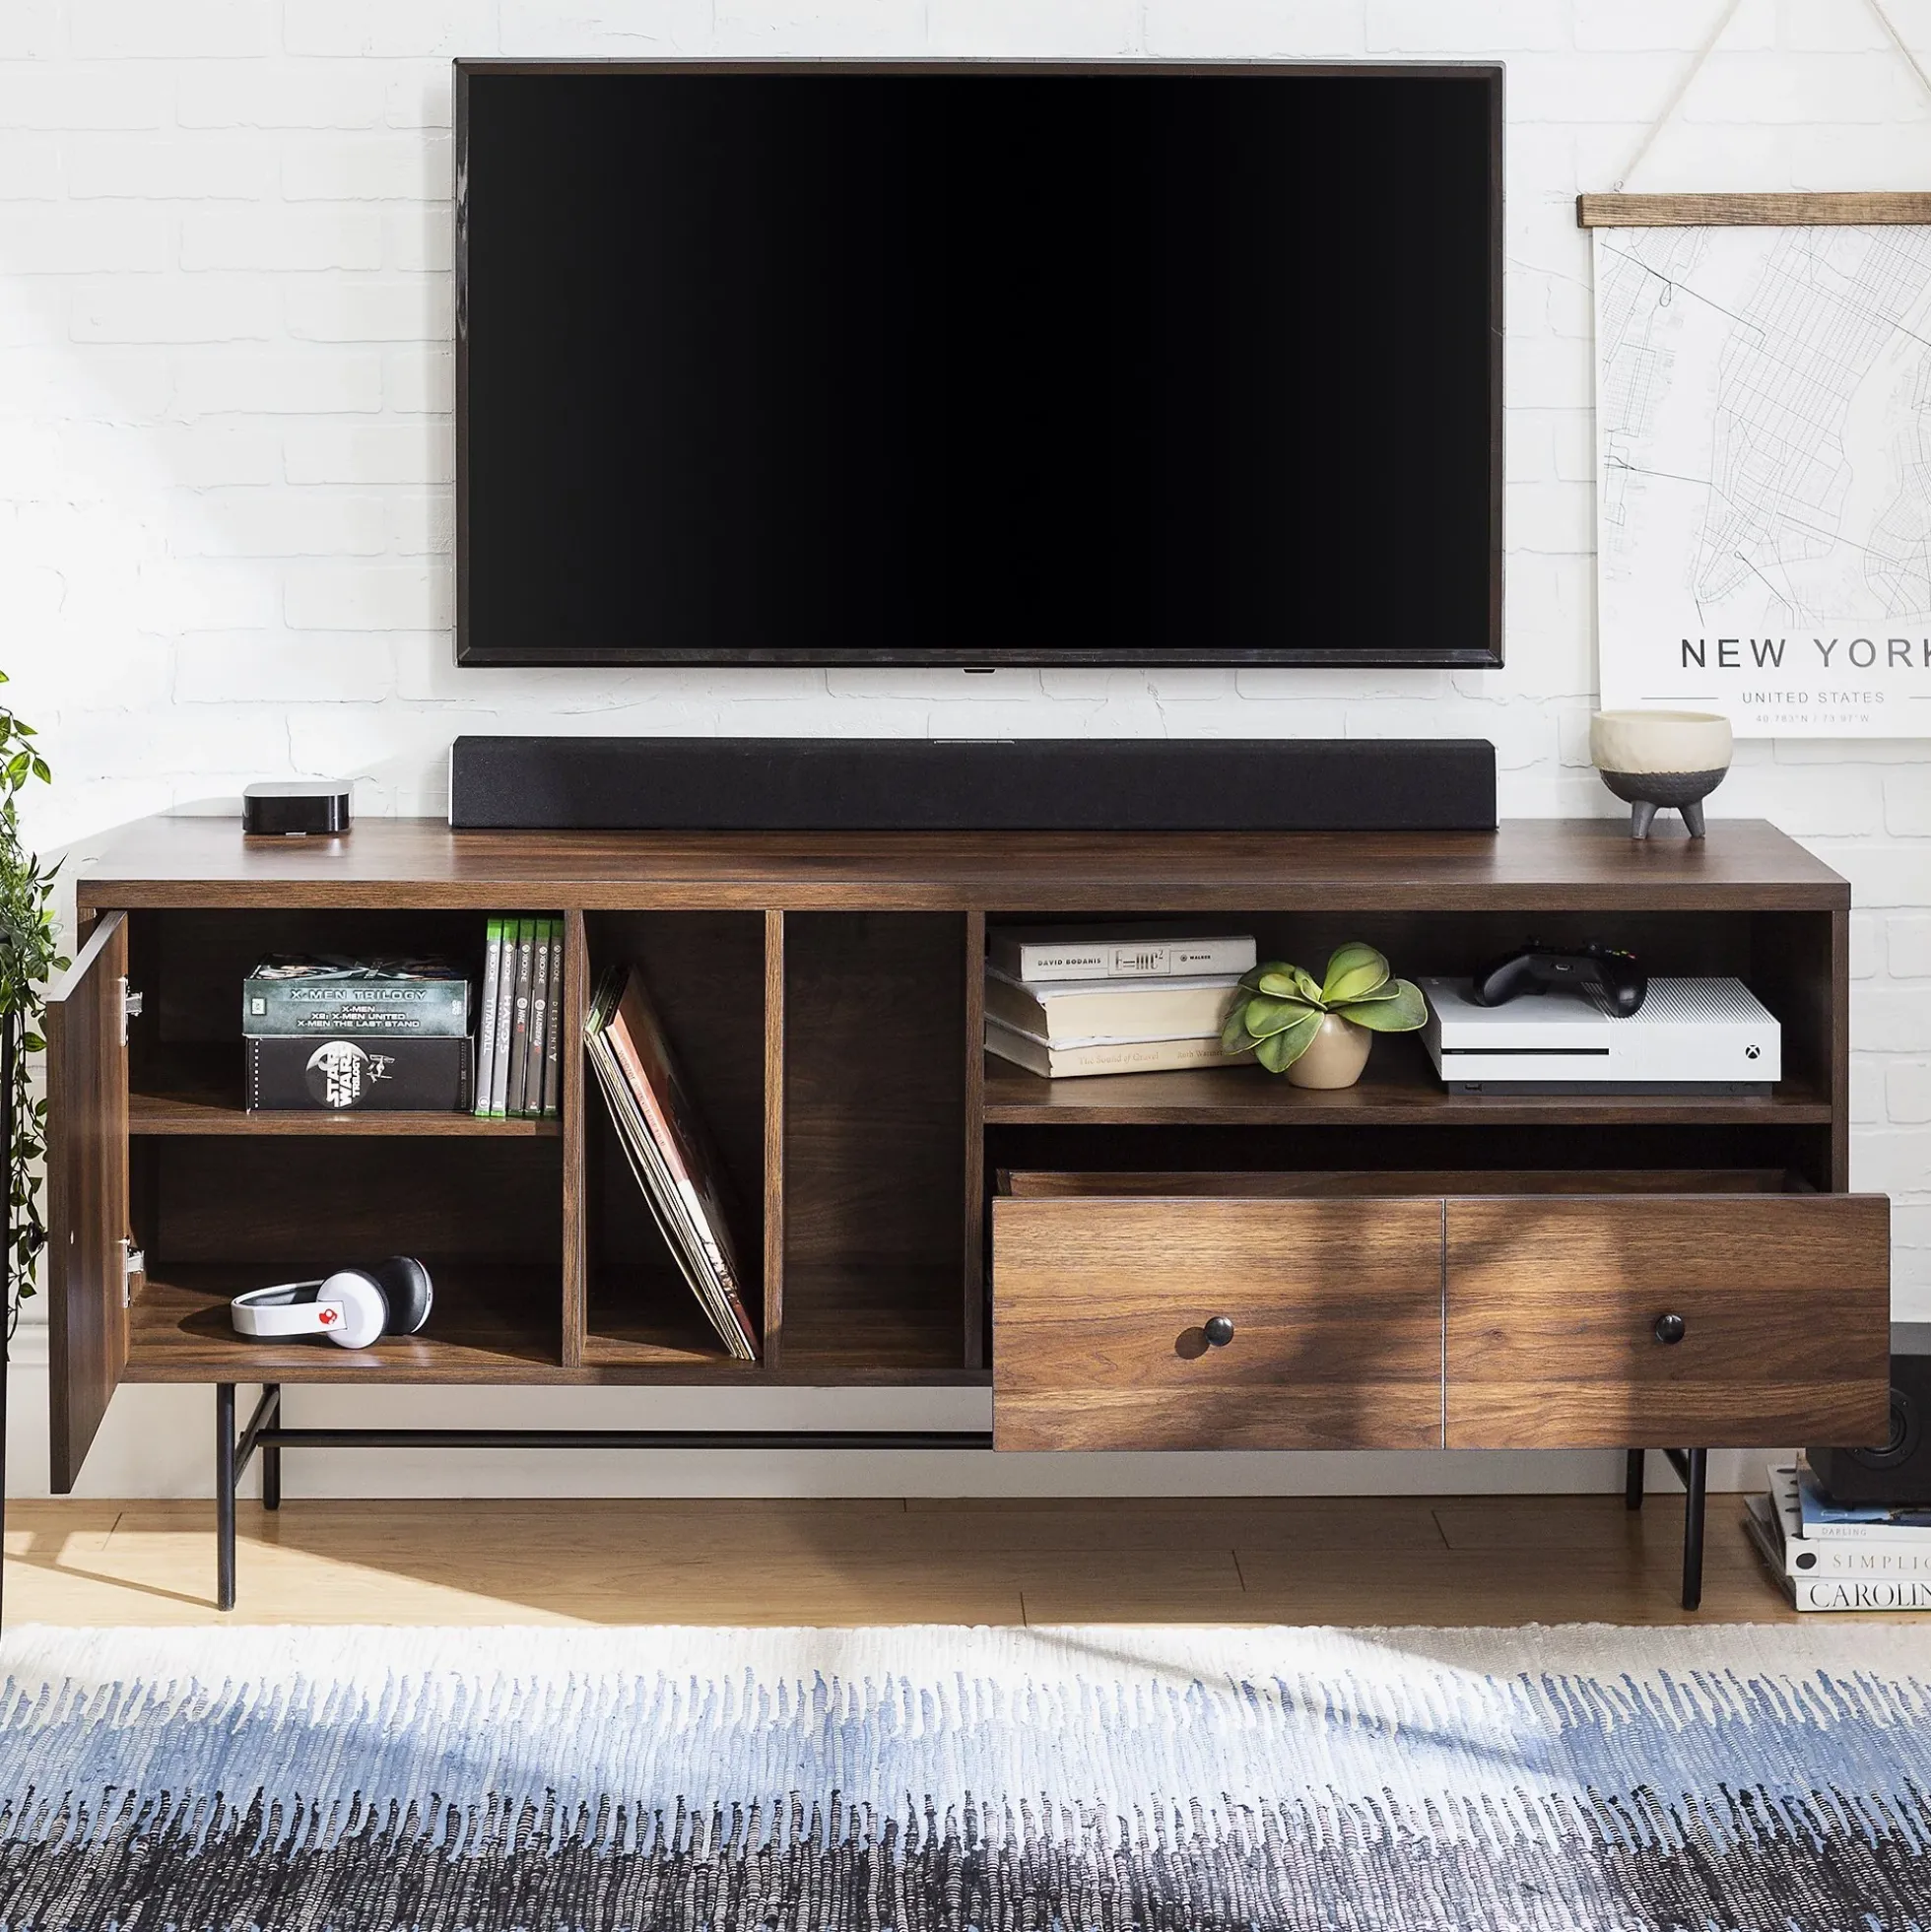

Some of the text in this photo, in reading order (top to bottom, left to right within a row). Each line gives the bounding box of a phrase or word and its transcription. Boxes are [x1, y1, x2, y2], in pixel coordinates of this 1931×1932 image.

[1681, 638, 1786, 668] NEW
[1742, 692, 1885, 703] UNITED STATES
[291, 989, 427, 1000] X-MEN TRILOGY
[483, 997, 495, 1056] TITANFALL
[517, 1009, 526, 1024] NHL
[535, 1010, 544, 1039] MADDEN
[550, 1001, 559, 1050] DESTINY
[325, 1048, 340, 1107] STAR
[339, 1046, 353, 1107] WARS
[352, 1054, 361, 1099] TRILOGY
[1822, 1527, 1867, 1536] DARLING
